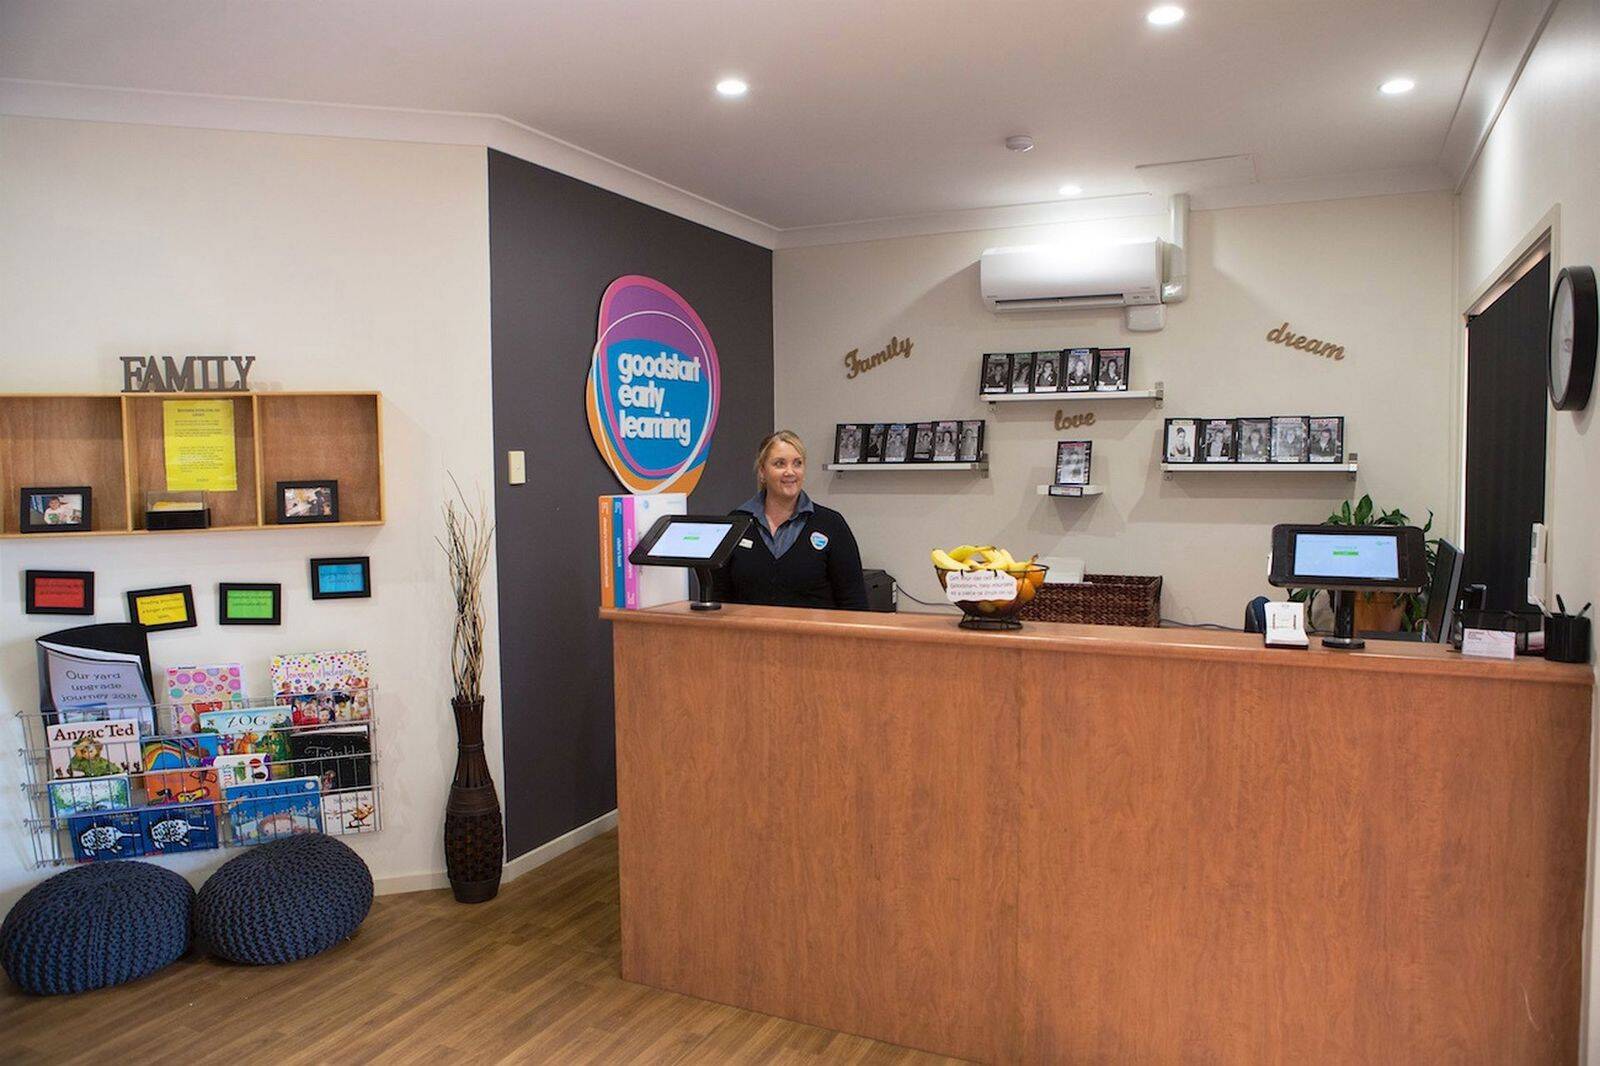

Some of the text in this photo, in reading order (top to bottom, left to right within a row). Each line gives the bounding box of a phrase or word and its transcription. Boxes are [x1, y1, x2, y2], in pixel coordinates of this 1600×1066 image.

[1266, 322, 1345, 361] dream
[119, 355, 256, 393] FAMILY
[618, 352, 700, 384] goodstart
[844, 336, 914, 380] Family
[618, 380, 665, 415] early
[619, 409, 691, 447] learning
[1054, 409, 1096, 431] love
[65, 670, 121, 681] Our yard
[71, 682, 122, 692] upgrade
[61, 692, 137, 702] journey 2019
[53, 723, 135, 741] Anzac Ted
